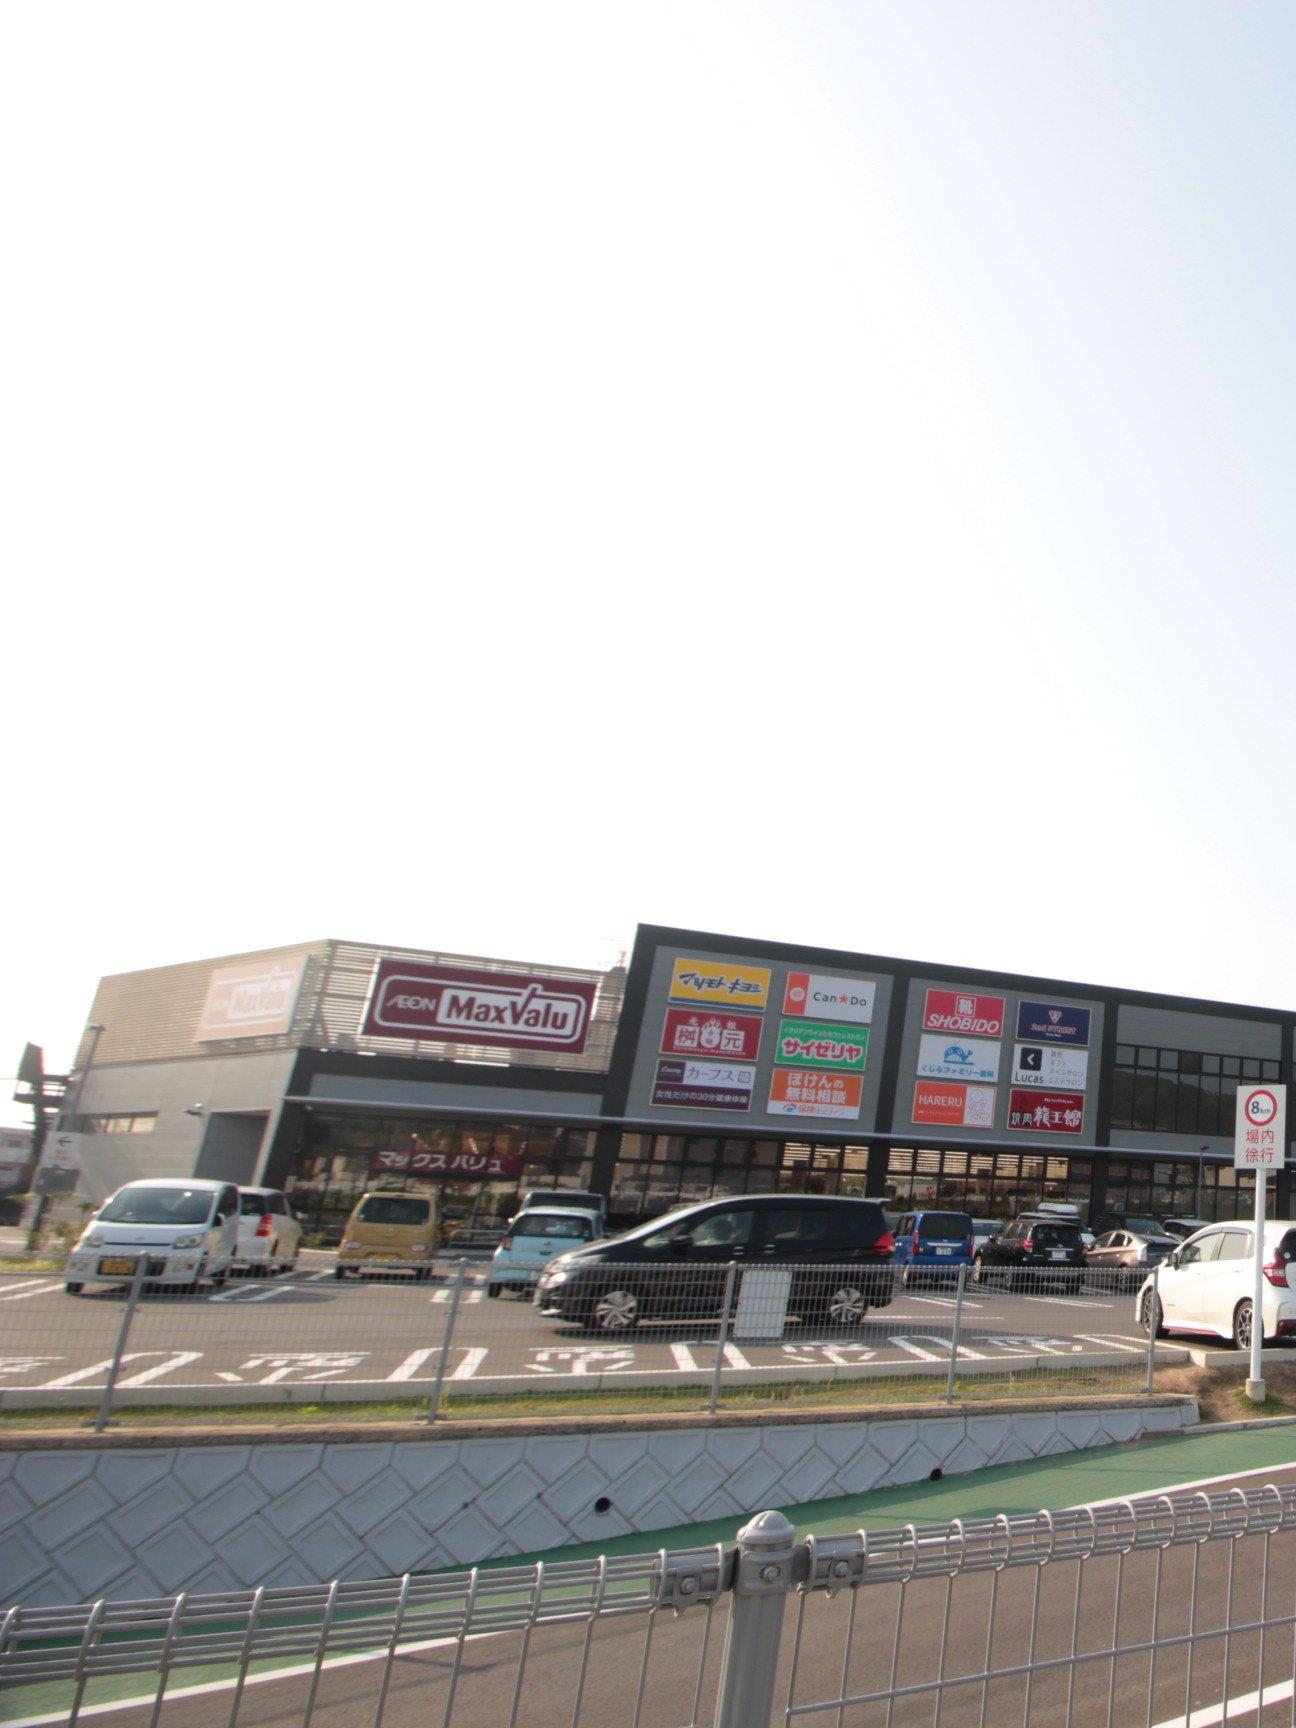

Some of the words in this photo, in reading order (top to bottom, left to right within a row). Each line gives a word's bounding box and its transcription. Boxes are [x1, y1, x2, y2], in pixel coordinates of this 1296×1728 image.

[445, 986, 569, 1030] MaxValu
[927, 1013, 1000, 1033] SHOBIDO
[782, 1037, 863, 1063] サイゼリヤ
[787, 1072, 844, 1088] ほけんの
[1014, 1071, 1044, 1084] Lucas
[785, 1086, 847, 1105] 無料相談
[919, 1094, 963, 1108] HARERU
[1246, 1129, 1275, 1144] 場内
[378, 1151, 506, 1173] マックスバリュ
[1245, 1147, 1275, 1163] 徐行
